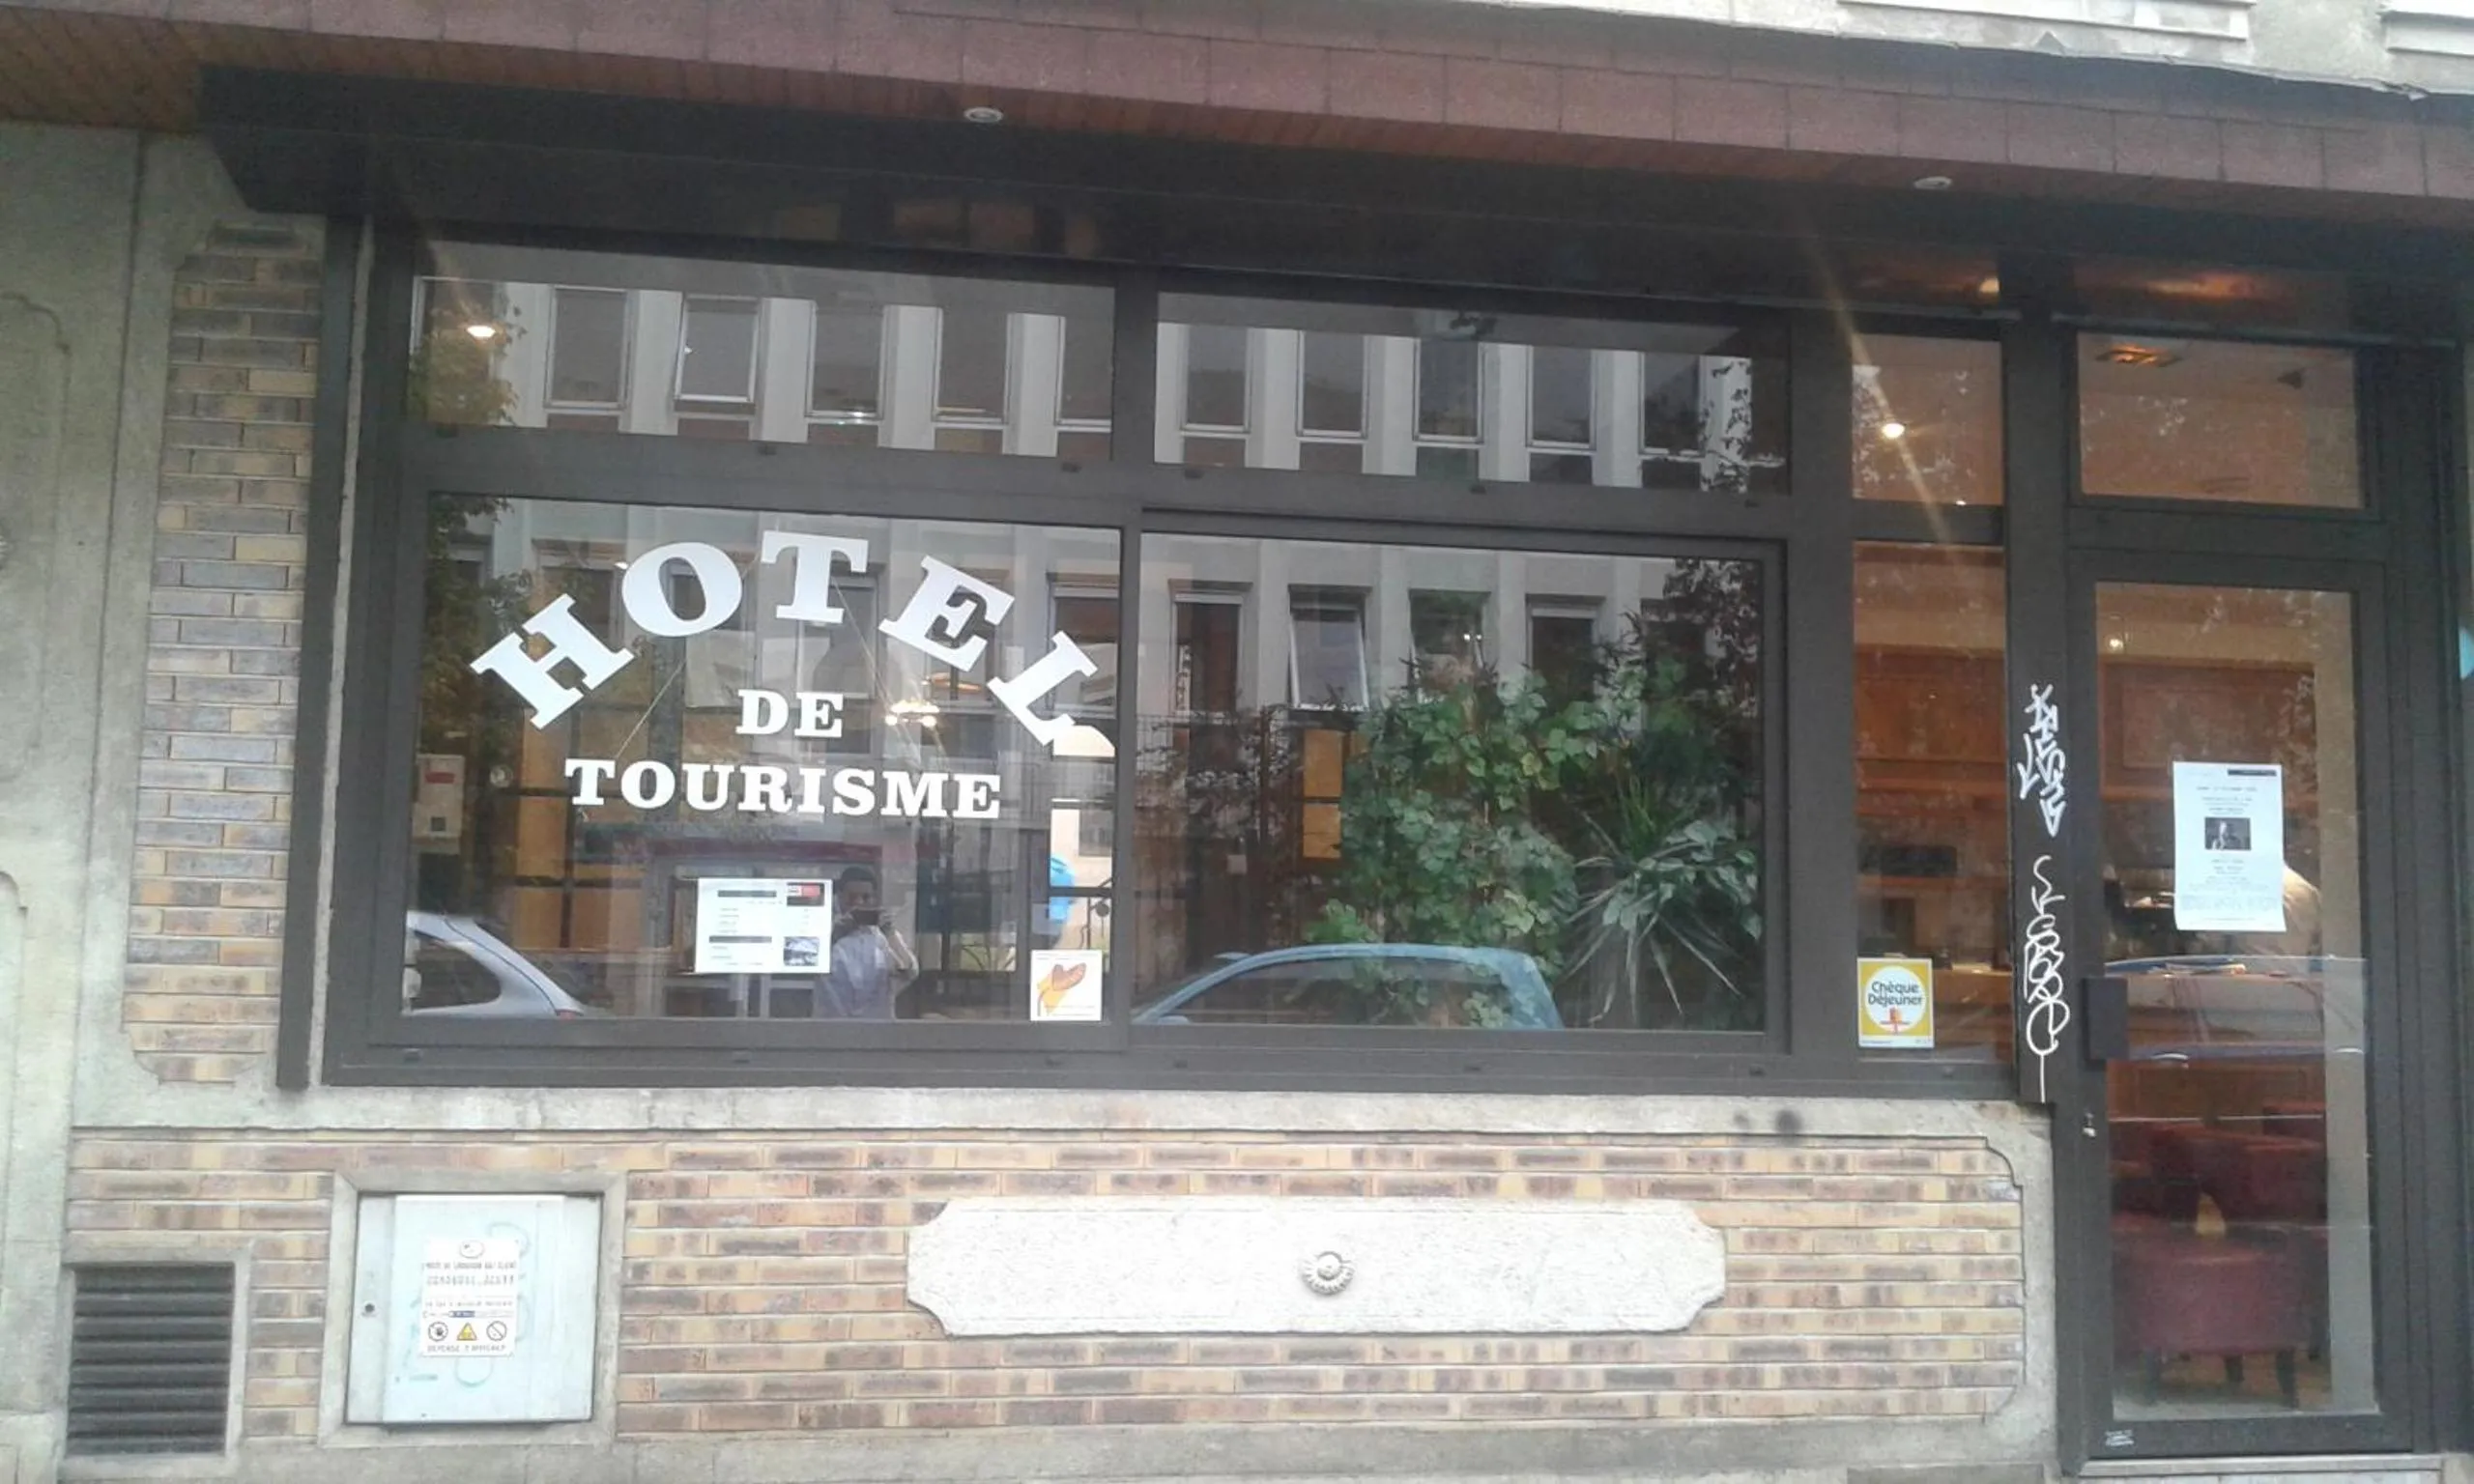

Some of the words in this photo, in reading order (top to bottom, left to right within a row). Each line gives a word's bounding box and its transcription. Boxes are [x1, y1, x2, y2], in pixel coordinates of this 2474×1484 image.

[470, 529, 1098, 747] HOTEL
[735, 688, 844, 738] DE
[564, 758, 1001, 819] TOURISME
